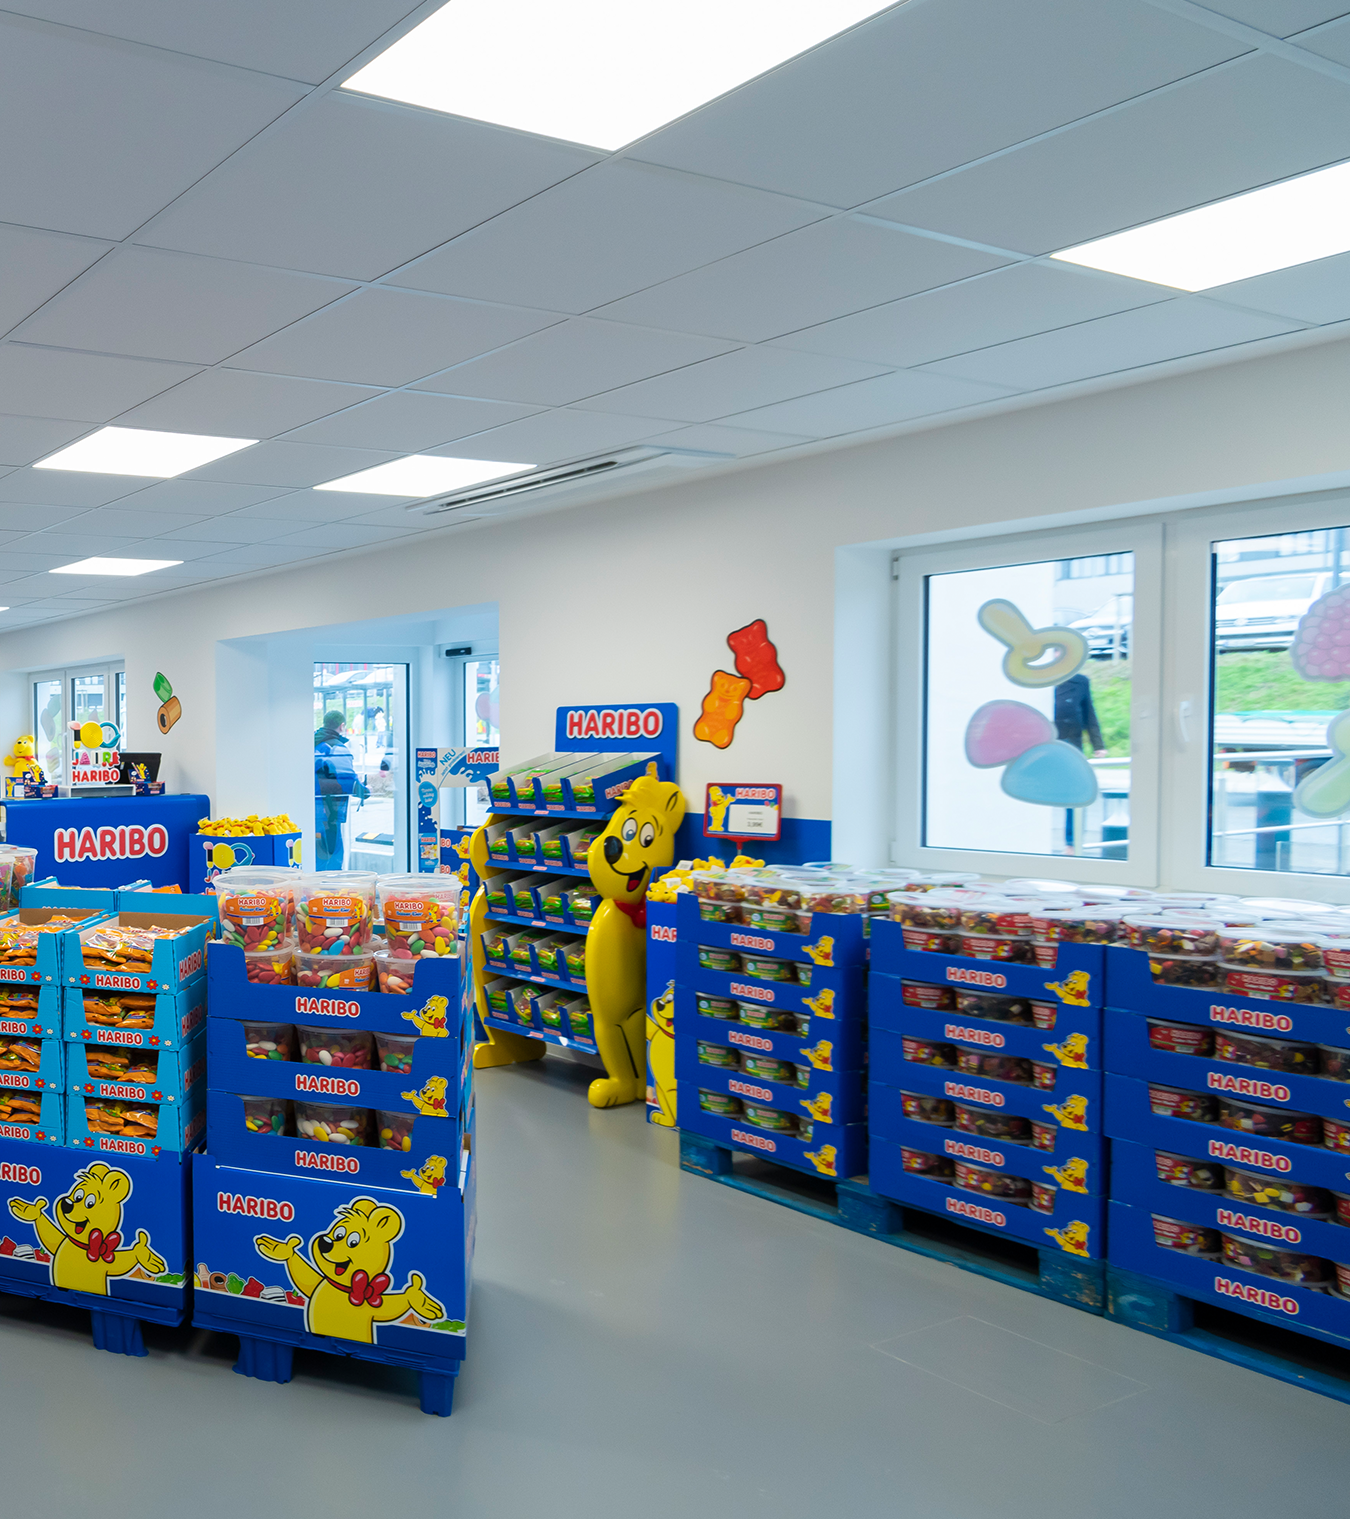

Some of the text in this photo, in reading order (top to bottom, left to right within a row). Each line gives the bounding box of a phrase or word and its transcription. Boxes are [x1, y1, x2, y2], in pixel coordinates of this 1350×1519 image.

[568, 709, 661, 738] HARIBO
[439, 749, 456, 766] NEU
[72, 769, 120, 782] HARIBO
[735, 788, 776, 800] HARIBO
[55, 824, 169, 863] HARIBO
[238, 898, 266, 906] HARIBO
[322, 898, 351, 907] HARIBO
[394, 902, 424, 911] HARIBO
[731, 933, 775, 951] HARIBO
[179, 949, 202, 982] HARIBO
[95, 974, 141, 989] HARIBO
[946, 967, 1007, 988] HARIBO
[730, 982, 775, 1001] HARIBO
[295, 997, 360, 1018] HARIBO
[1210, 1005, 1293, 1032] HARIBO
[97, 1030, 143, 1045] HARIBO
[728, 1031, 773, 1051] HARIBO
[944, 1024, 1005, 1048] HARIBO
[100, 1085, 146, 1100] HARIBO
[295, 1075, 360, 1096] HARIBO
[728, 1080, 773, 1102] HARIBO
[944, 1082, 1005, 1107] HARIBO
[1207, 1072, 1291, 1102] HARIBO
[100, 1138, 146, 1155] HARIBO
[731, 1129, 776, 1152] HARIBO
[295, 1151, 359, 1174] HARIBO
[944, 1139, 1005, 1166] HARIBO
[1208, 1140, 1292, 1172] HARIBO
[217, 1191, 294, 1222] HARIBO
[946, 1198, 1006, 1226] HARIBO
[1217, 1208, 1301, 1244] HARIBO
[1214, 1276, 1299, 1315] HARIBO
